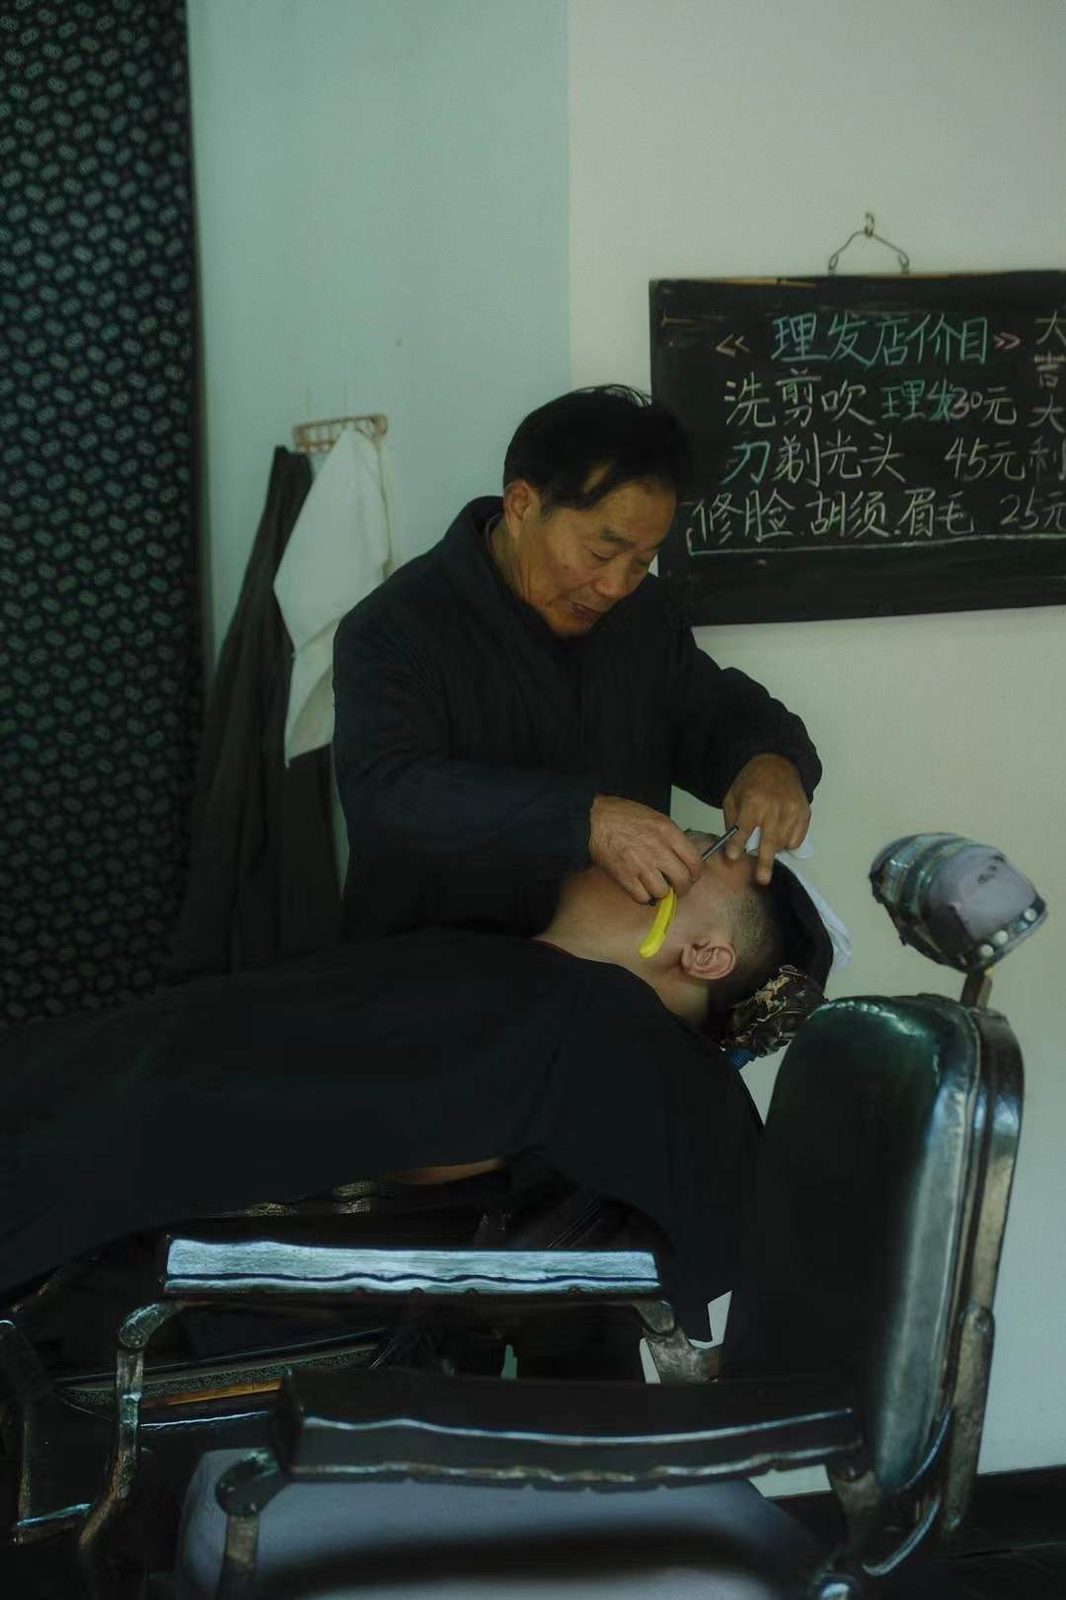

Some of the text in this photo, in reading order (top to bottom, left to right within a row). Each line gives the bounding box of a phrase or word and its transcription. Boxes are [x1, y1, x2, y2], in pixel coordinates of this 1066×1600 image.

[1027, 309, 1066, 481] 大吉大利
[943, 436, 1025, 483] 45元
[1000, 486, 1066, 531] 25元
